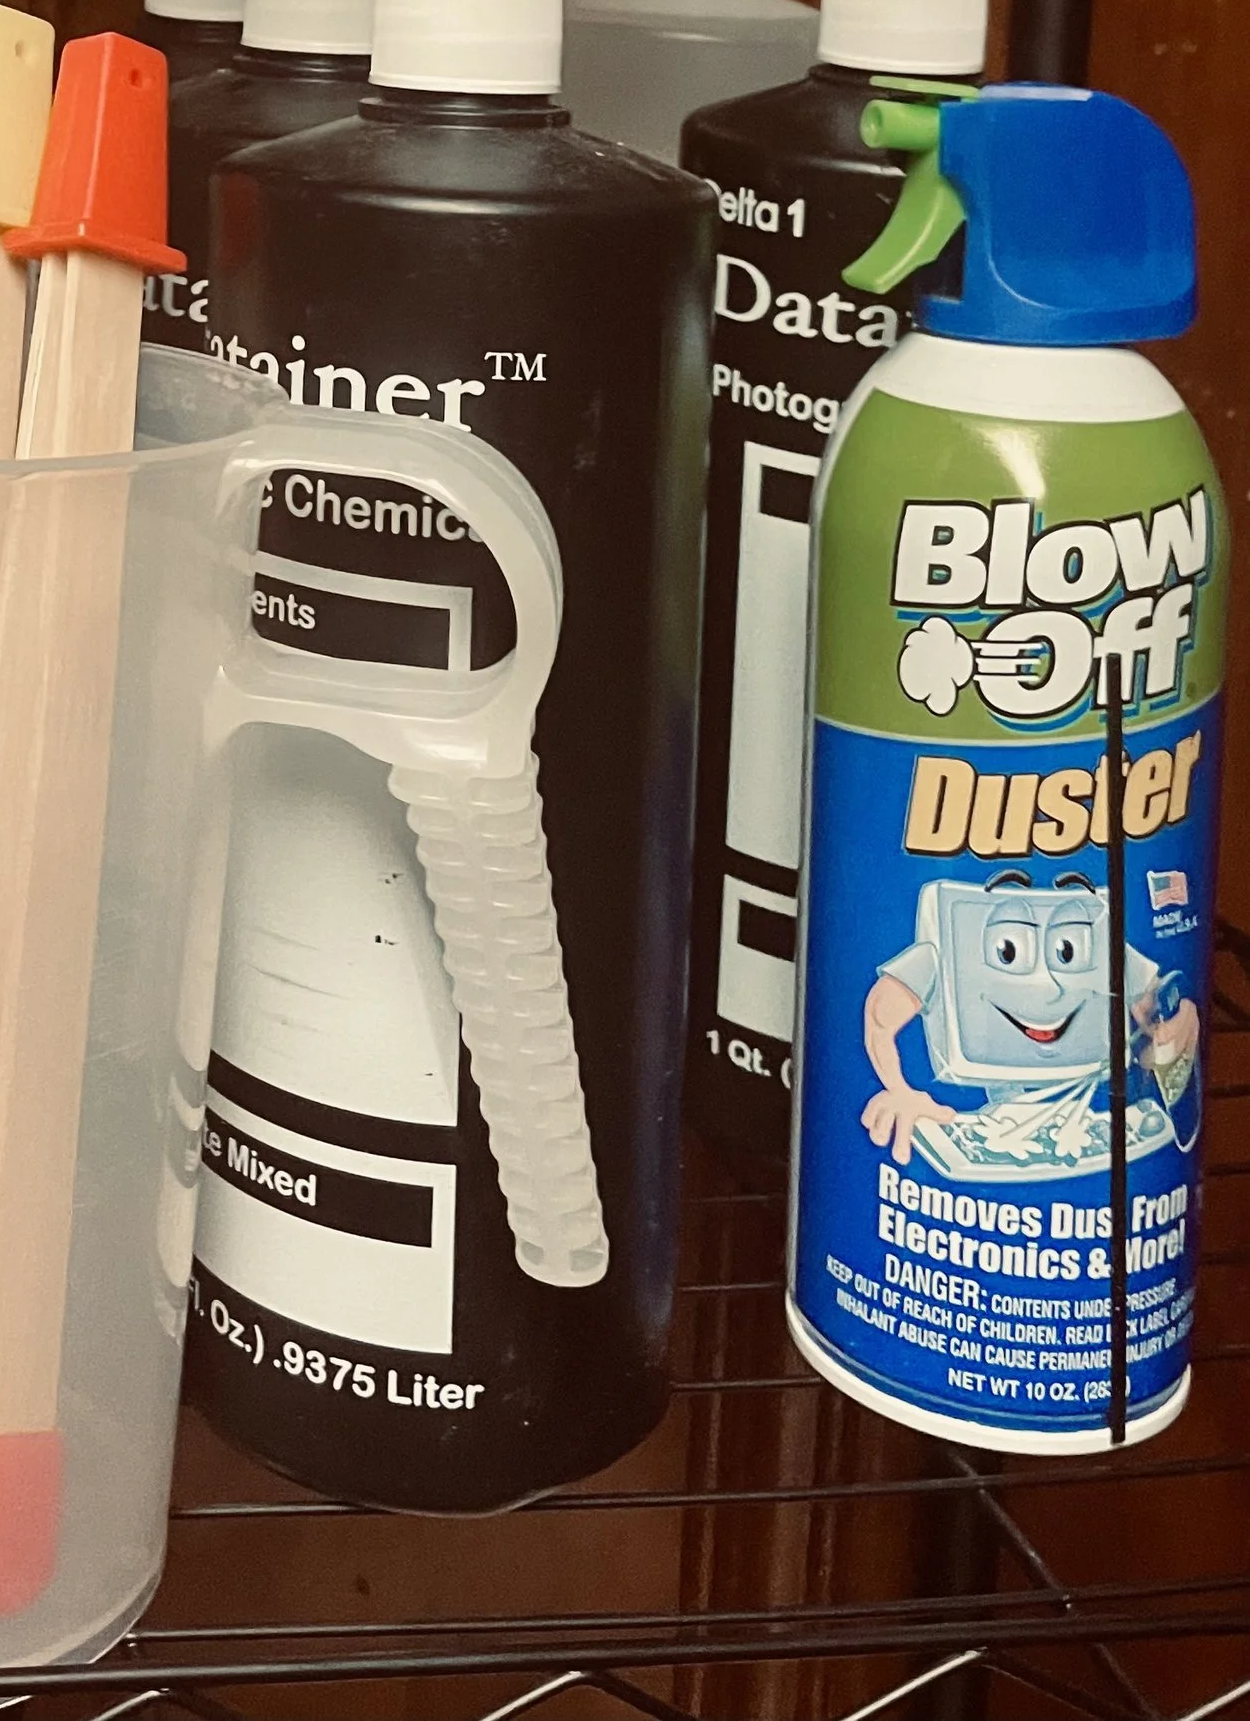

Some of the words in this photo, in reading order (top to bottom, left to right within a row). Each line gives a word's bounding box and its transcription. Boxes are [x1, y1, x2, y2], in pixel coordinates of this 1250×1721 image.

[705, 178, 779, 233] elta
[786, 198, 806, 238] 1
[714, 253, 901, 348] Data
[712, 363, 842, 434] Photog
[890, 485, 1210, 610] Blow
[974, 583, 1196, 718] Off
[706, 1030, 720, 1055] 1
[727, 1039, 771, 1077] Qt.
[227, 1136, 318, 1207] Mixed
[878, 1163, 1043, 1239] Removes
[1049, 1201, 1113, 1240] Dus
[1131, 1183, 1189, 1233] From
[877, 1202, 1081, 1281] Electronics
[1087, 1247, 1113, 1280] &
[825, 1253, 853, 1285] KEEP
[854, 1272, 881, 1301] OUT
[882, 1287, 902, 1310] OF
[903, 1295, 953, 1330] REACH
[956, 1311, 978, 1335] OF
[980, 1317, 1062, 1346] CHILDREN.
[1065, 1322, 1106, 1346] READ
[885, 1252, 988, 1312] DANGER:
[991, 1293, 1071, 1320] CONTENTS
[1074, 1296, 1113, 1320] UNDE
[210, 1299, 265, 1365] Oz.)
[272, 1340, 377, 1399] .9375
[387, 1369, 486, 1410] Liter
[836, 1287, 897, 1336] INHALANT
[898, 1320, 948, 1354] ABUSE
[949, 1336, 982, 1362] CAN
[985, 1344, 1036, 1371] CAUSE
[1039, 1348, 1113, 1371] PERMANE
[947, 1367, 987, 1393] NET
[990, 1375, 1021, 1399] WT
[1026, 1382, 1046, 1401] 10
[1049, 1382, 1081, 1401] OZ.
